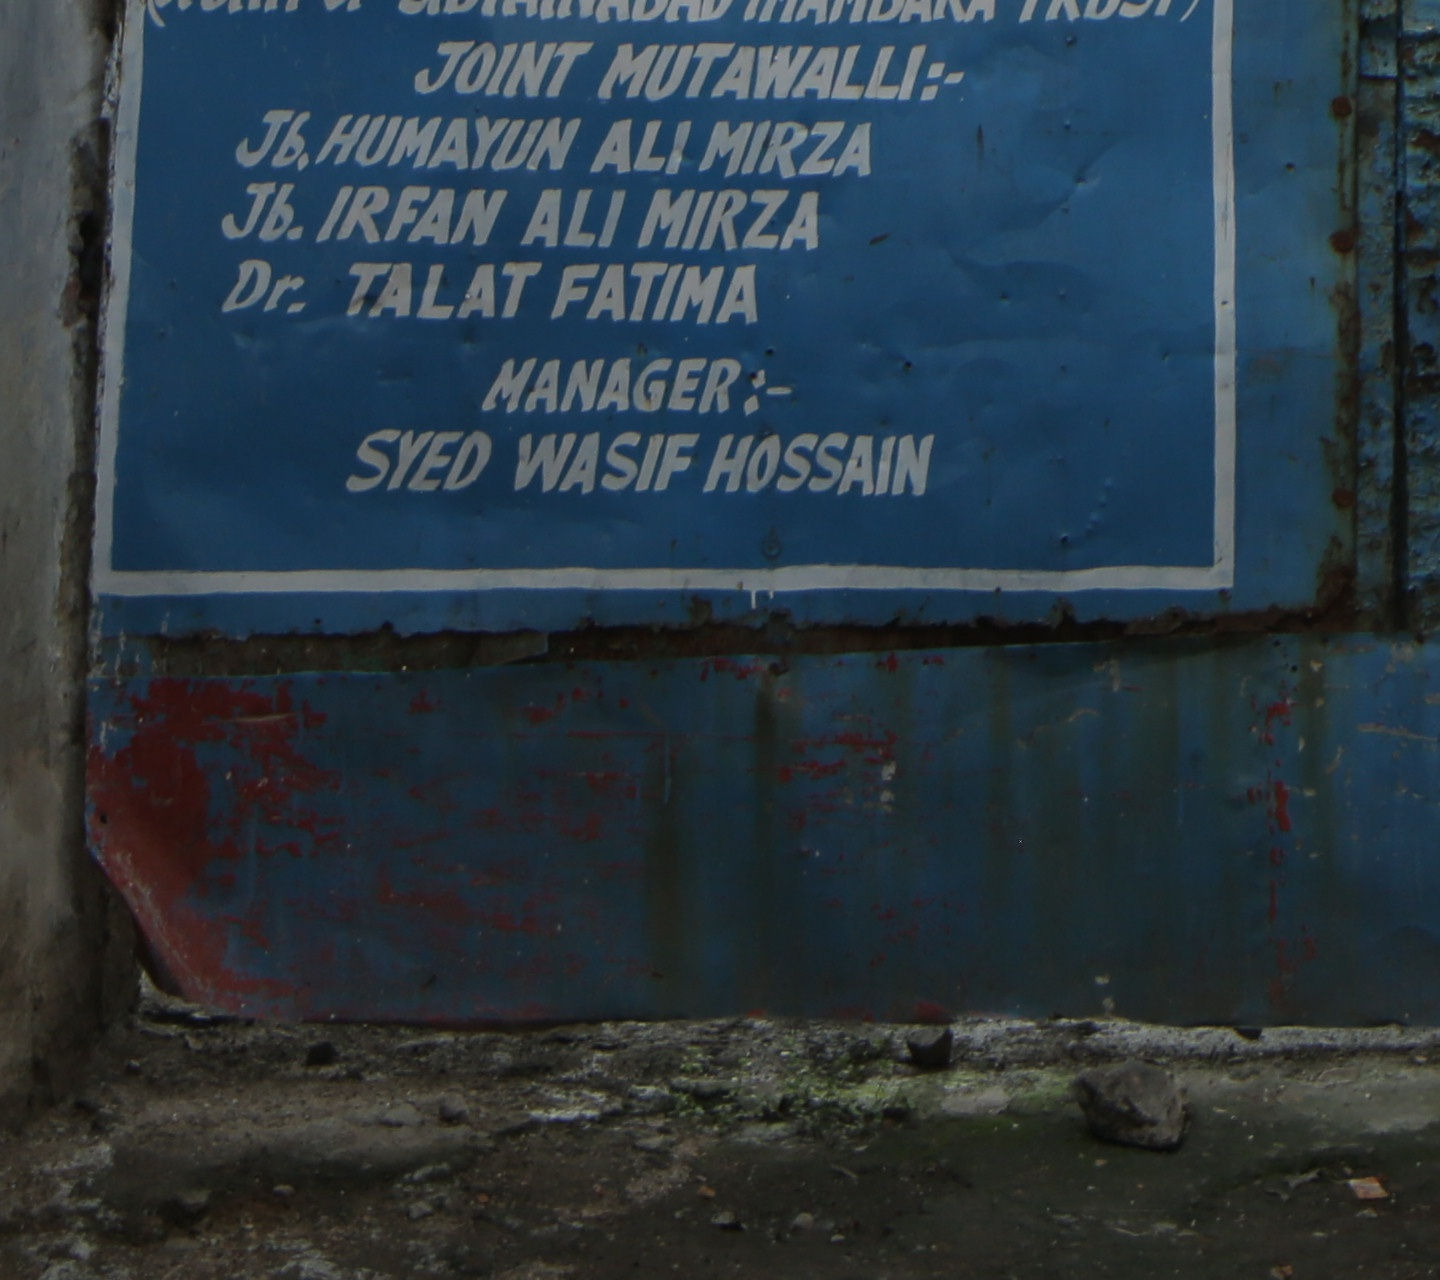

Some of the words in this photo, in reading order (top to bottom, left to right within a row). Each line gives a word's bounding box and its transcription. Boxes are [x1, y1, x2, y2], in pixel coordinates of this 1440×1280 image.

[414, 40, 594, 97] JOINT
[590, 119, 691, 174] ALI
[699, 121, 871, 178] MIRZA
[315, 185, 507, 246] IRFAN
[521, 189, 625, 248] ALI
[637, 189, 819, 251] MIRZA
[222, 260, 305, 314] Dr.
[346, 262, 541, 320] TALAT
[552, 262, 758, 324] FATIMA
[346, 429, 491, 493] SYED
[513, 432, 699, 494] WASIF
[703, 433, 934, 496] HOSSAIN
